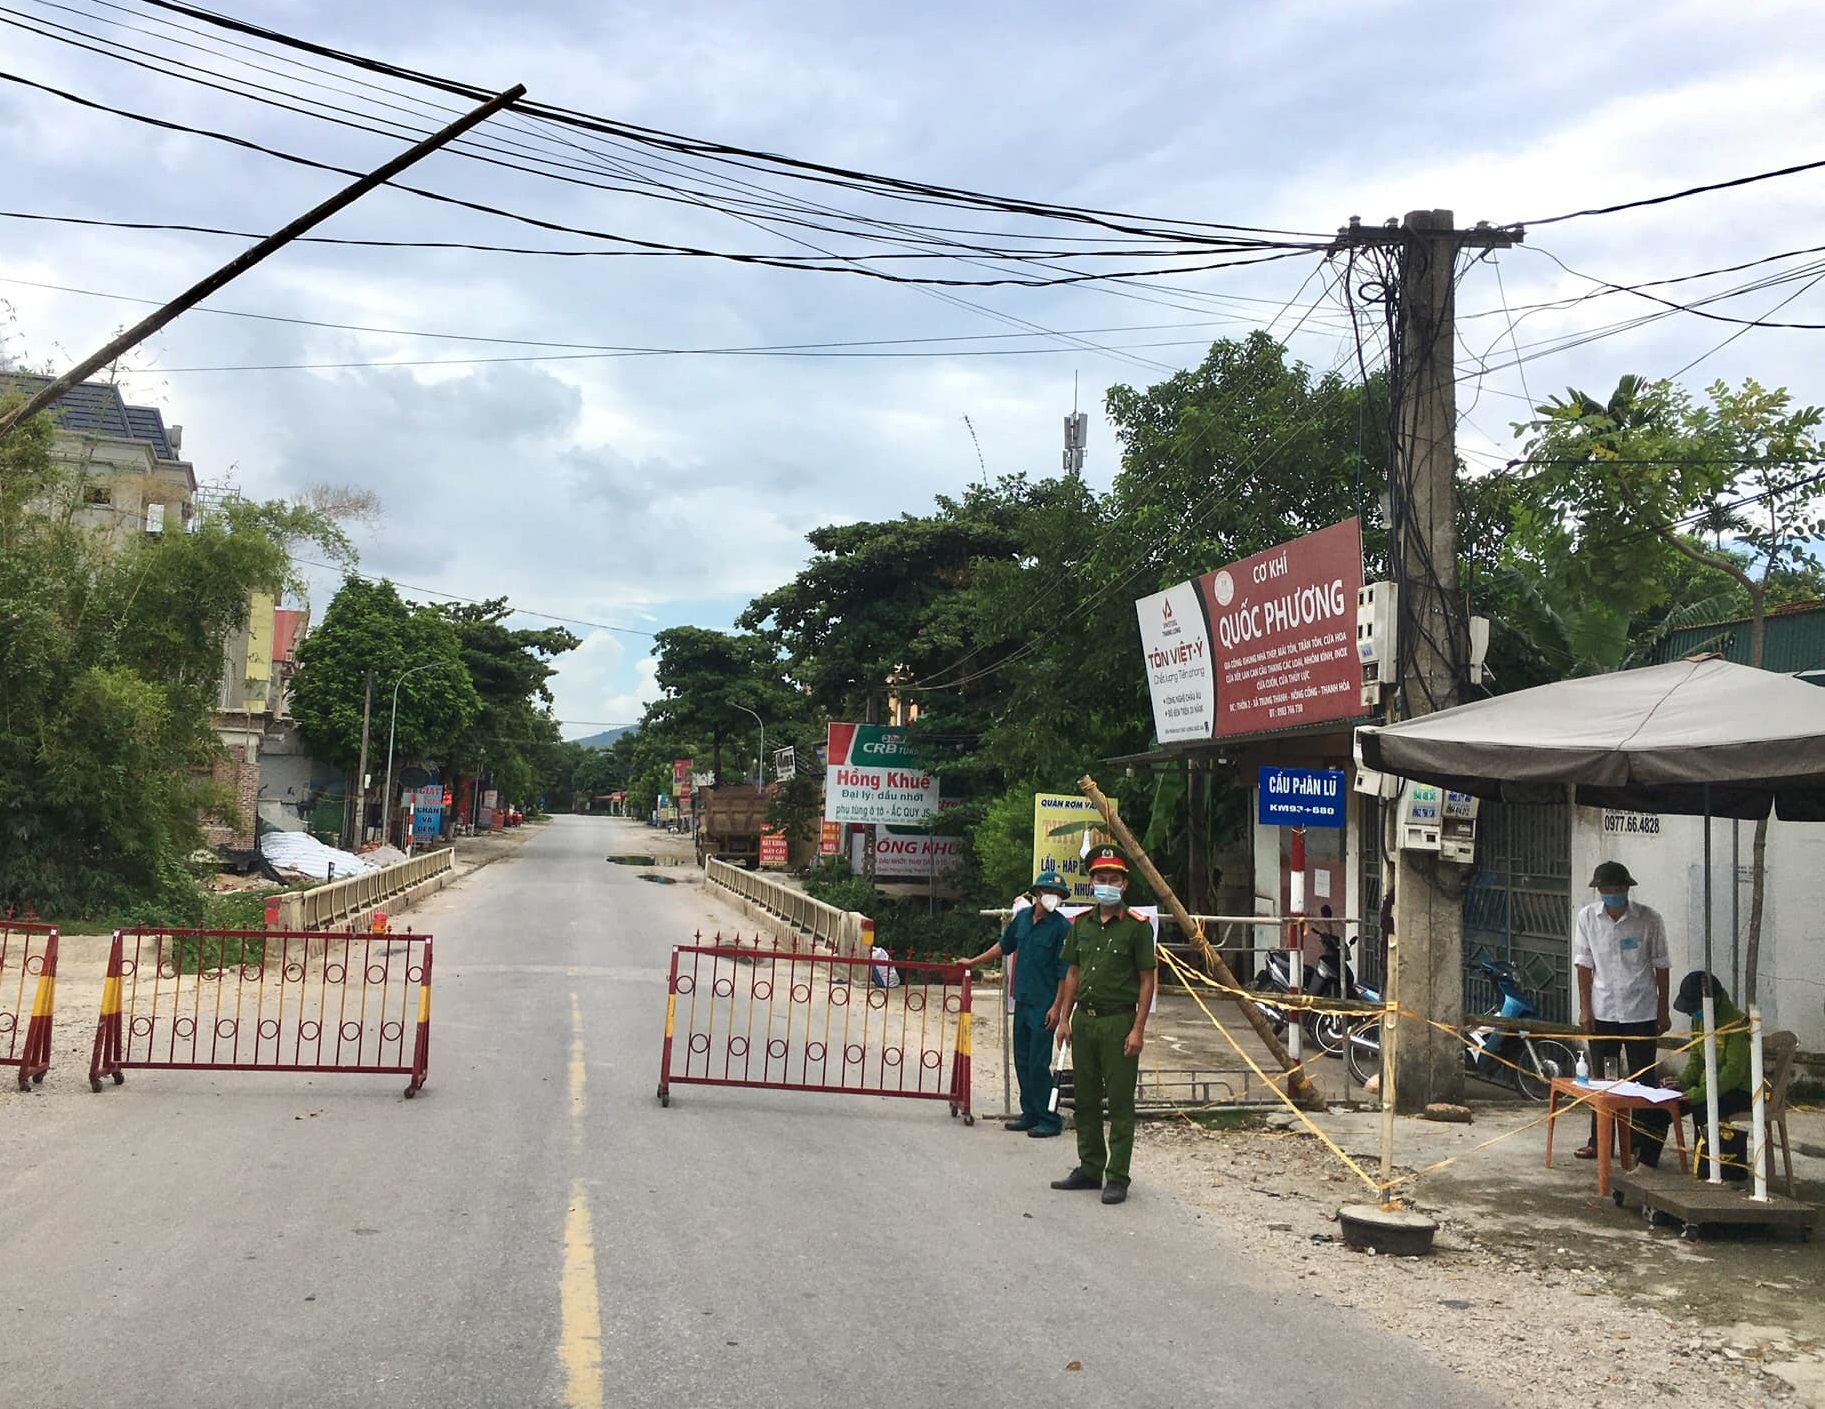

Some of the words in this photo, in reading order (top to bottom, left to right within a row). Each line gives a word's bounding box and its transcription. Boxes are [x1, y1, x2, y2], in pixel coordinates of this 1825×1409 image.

[1253, 563, 1267, 584] CƠ
[1270, 550, 1288, 579] KHÍ
[1219, 597, 1261, 649] QUỐC
[1265, 579, 1345, 634] PHƯƠNG
[1335, 631, 1347, 642] HOA
[1148, 646, 1169, 669] TÔN
[1334, 647, 1348, 659] INOX
[1320, 683, 1339, 694] THANH
[863, 742, 896, 754] CRB
[836, 768, 880, 790] Hồng
[887, 770, 930, 789] Khuê
[1269, 771, 1290, 794] CẦU
[1293, 775, 1321, 795] PHÂN
[1323, 775, 1337, 796] LŨ
[842, 789, 859, 800] Đại
[862, 790, 874, 801] lý:
[877, 790, 897, 800] dầu
[1041, 798, 1063, 808] QUÁN
[851, 804, 868, 817] tùng
[870, 806, 875, 816] ô
[876, 806, 884, 816] tô
[891, 804, 902, 817] ẮC
[903, 807, 919, 818] QUY
[1604, 815, 1660, 834] 0977.66.4828
[877, 837, 917, 854] ỒNG
[921, 841, 960, 855] KHU
[1062, 855, 1078, 873] HẤP
